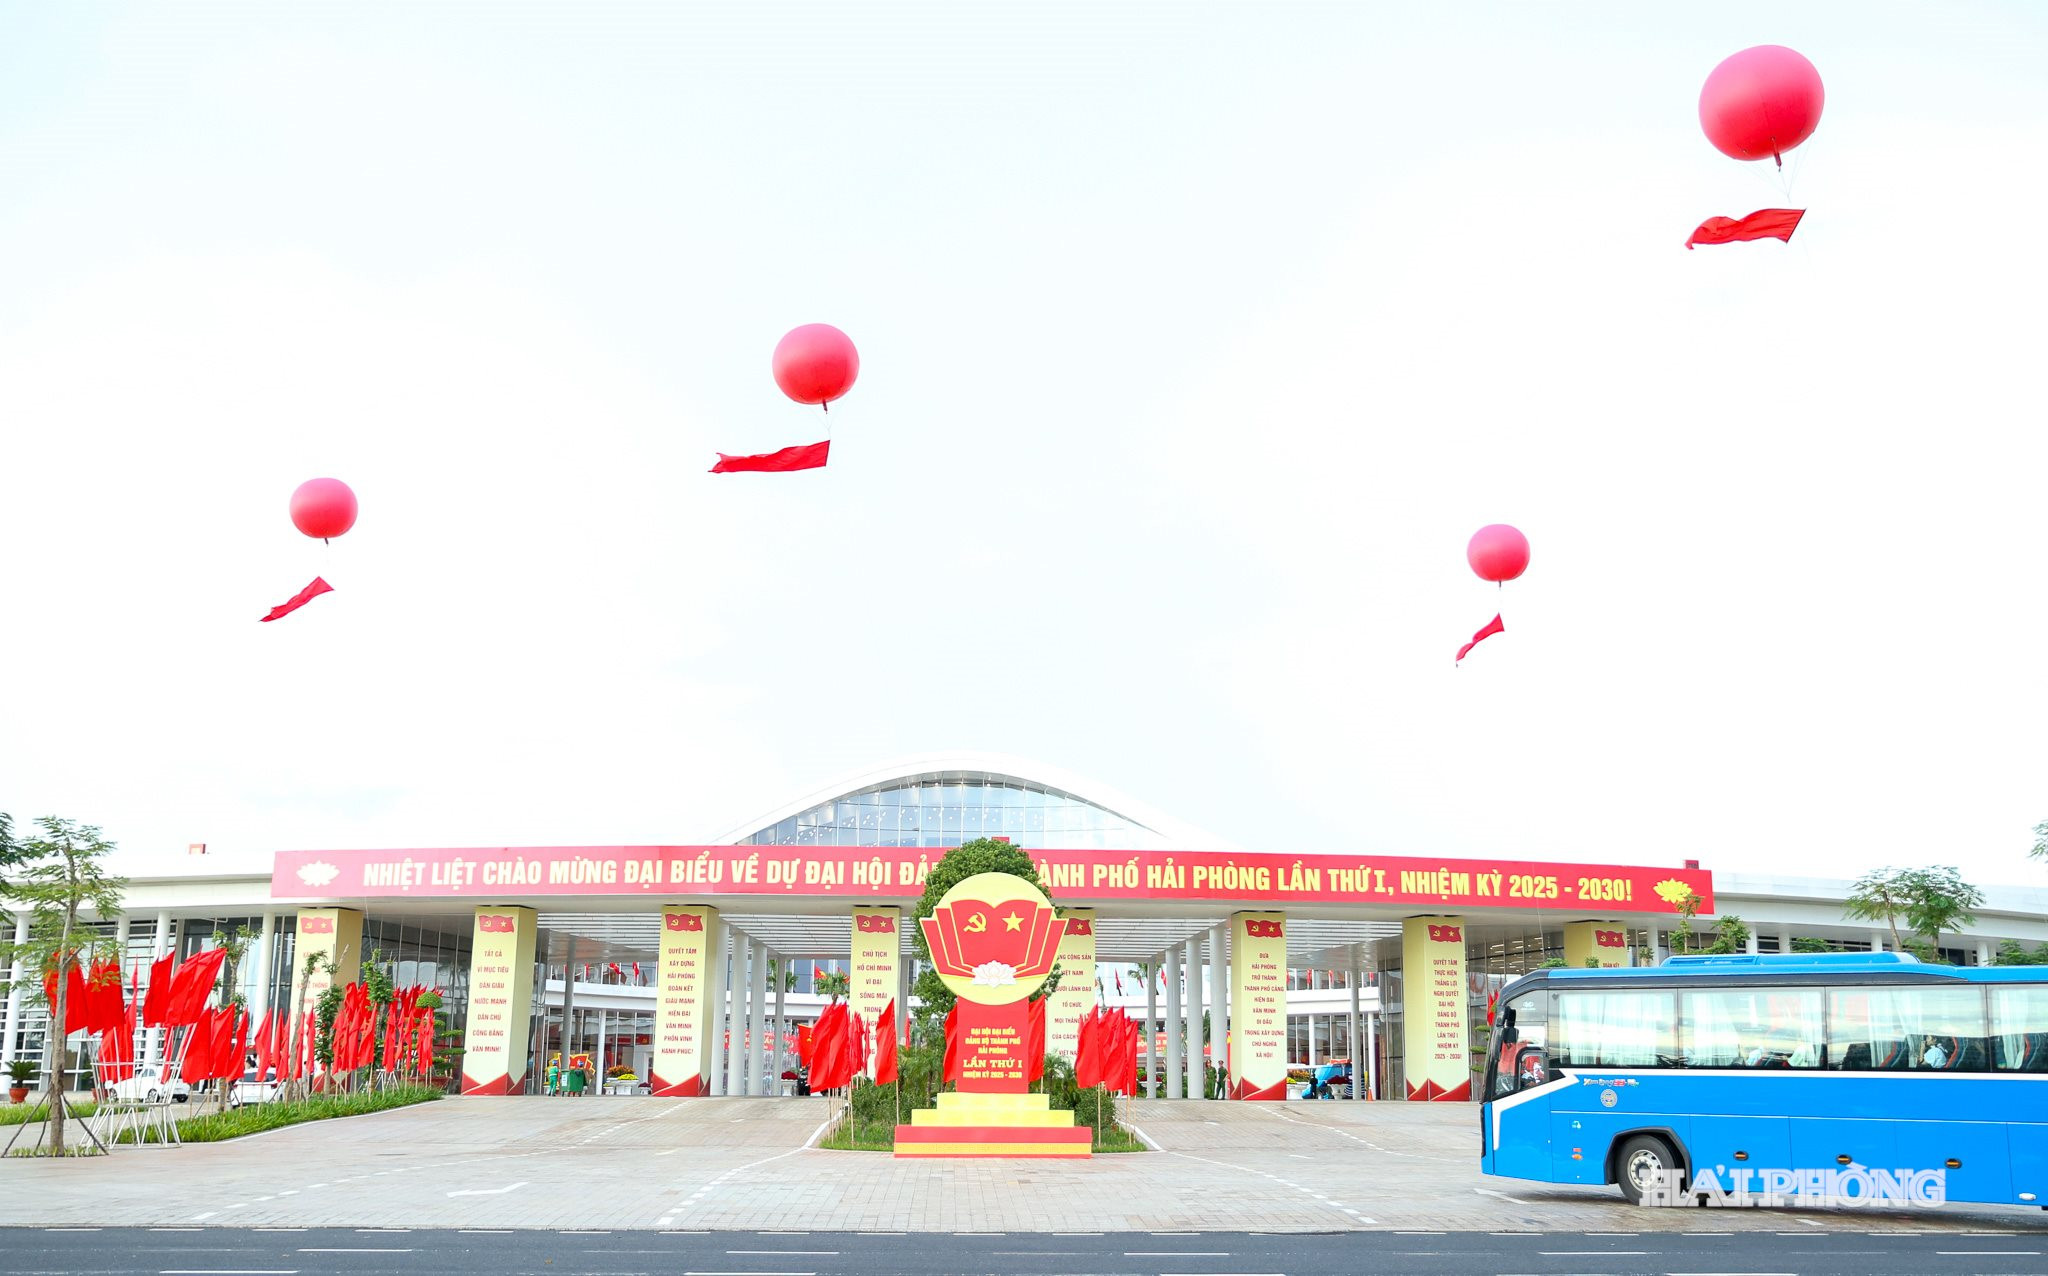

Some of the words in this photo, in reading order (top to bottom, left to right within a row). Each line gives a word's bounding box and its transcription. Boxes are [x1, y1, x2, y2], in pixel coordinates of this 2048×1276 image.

[363, 857, 426, 890] NHIỆT
[431, 857, 477, 890] LIỆT
[483, 856, 542, 885] CHÀO
[549, 855, 617, 884] MỪNG
[624, 859, 663, 889] ĐẠI
[670, 851, 723, 884] BIỂU
[731, 852, 759, 884] VỀ
[766, 858, 800, 889] DỰ
[805, 861, 844, 889] ĐẠI
[852, 857, 891, 890] HỘI
[899, 854, 936, 885] ĐẢ
[1036, 859, 1085, 887] ÀNH
[1093, 857, 1140, 888] PHỐ
[1147, 857, 1185, 889] HẢI
[1193, 860, 1271, 890] PHÒNG
[1277, 860, 1320, 892] LẦN
[1328, 864, 1370, 892] THỨ
[1401, 867, 1470, 899] NHIỆM
[1477, 869, 1502, 897] KỲ
[1509, 875, 1558, 899] 2025
[1578, 877, 1633, 902] 2030!
[862, 948, 873, 957] CHỦ
[875, 951, 887, 959] TỊCH
[1081, 952, 1092, 960] SẢN
[1018, 1060, 1022, 1068] I
